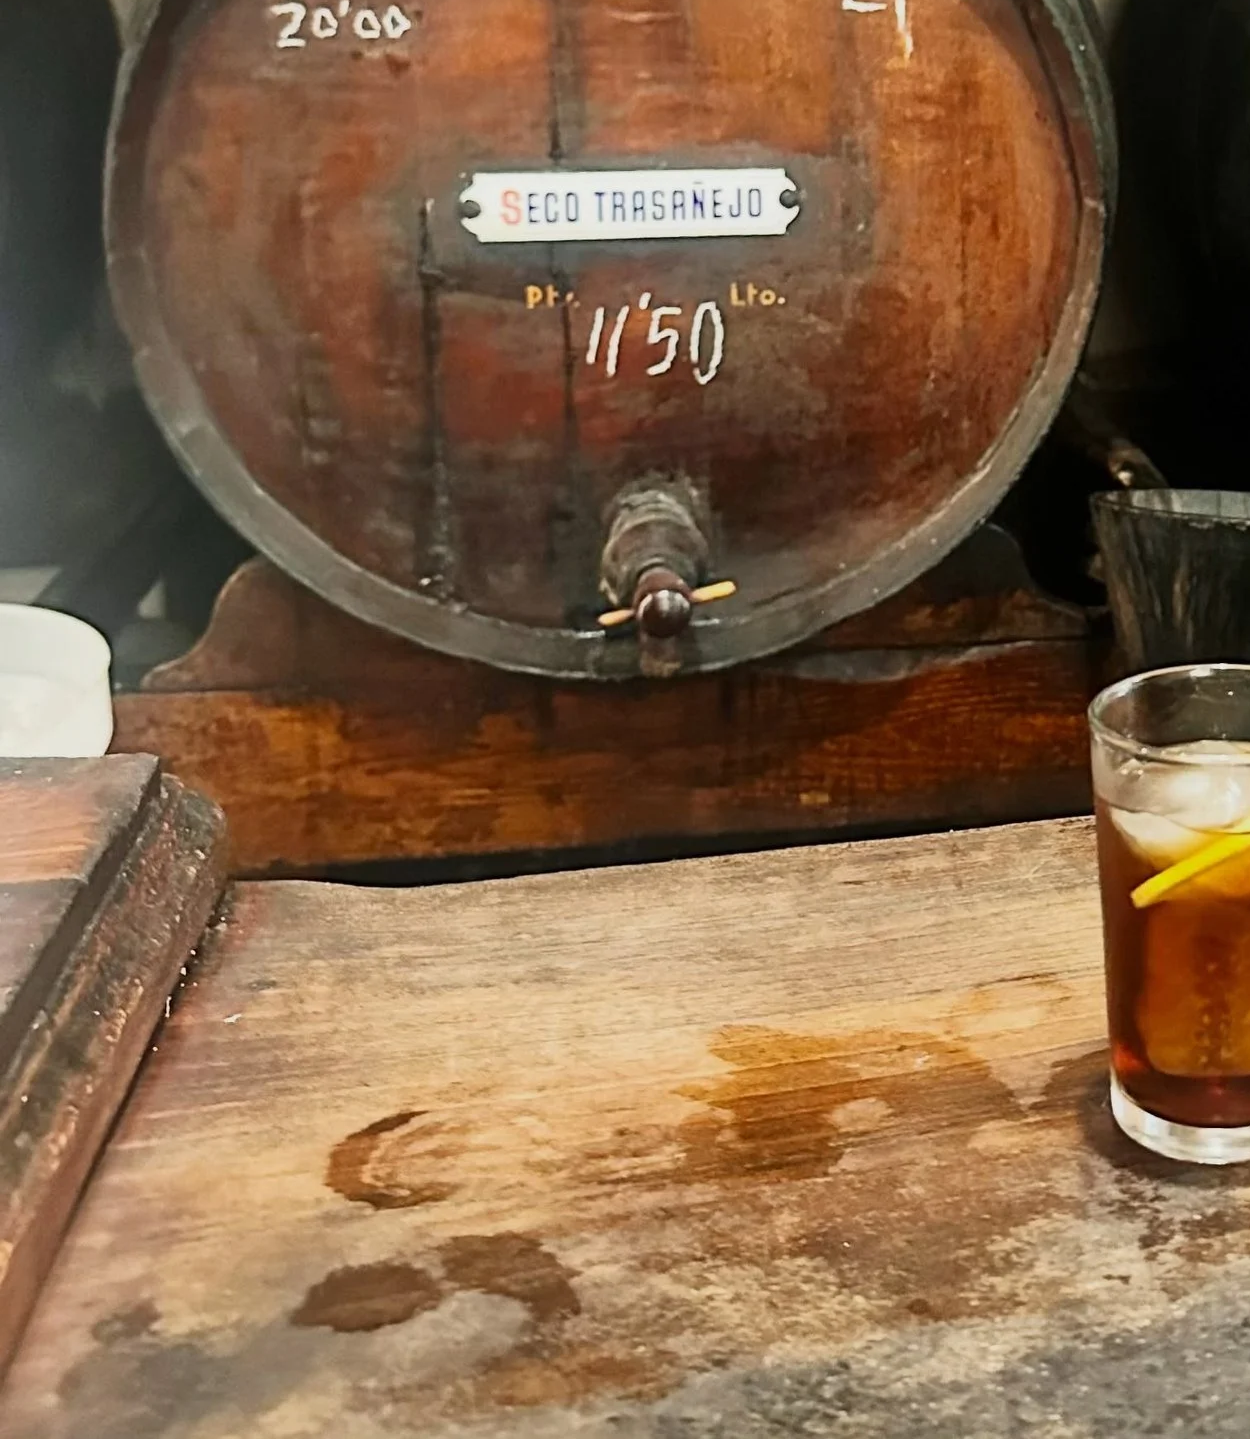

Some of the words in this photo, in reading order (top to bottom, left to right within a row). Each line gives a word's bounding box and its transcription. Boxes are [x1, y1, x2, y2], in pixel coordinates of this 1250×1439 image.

[501, 189, 580, 226] SECO
[594, 181, 763, 223] TRASAÑEJO
[730, 281, 787, 308] Lto.
